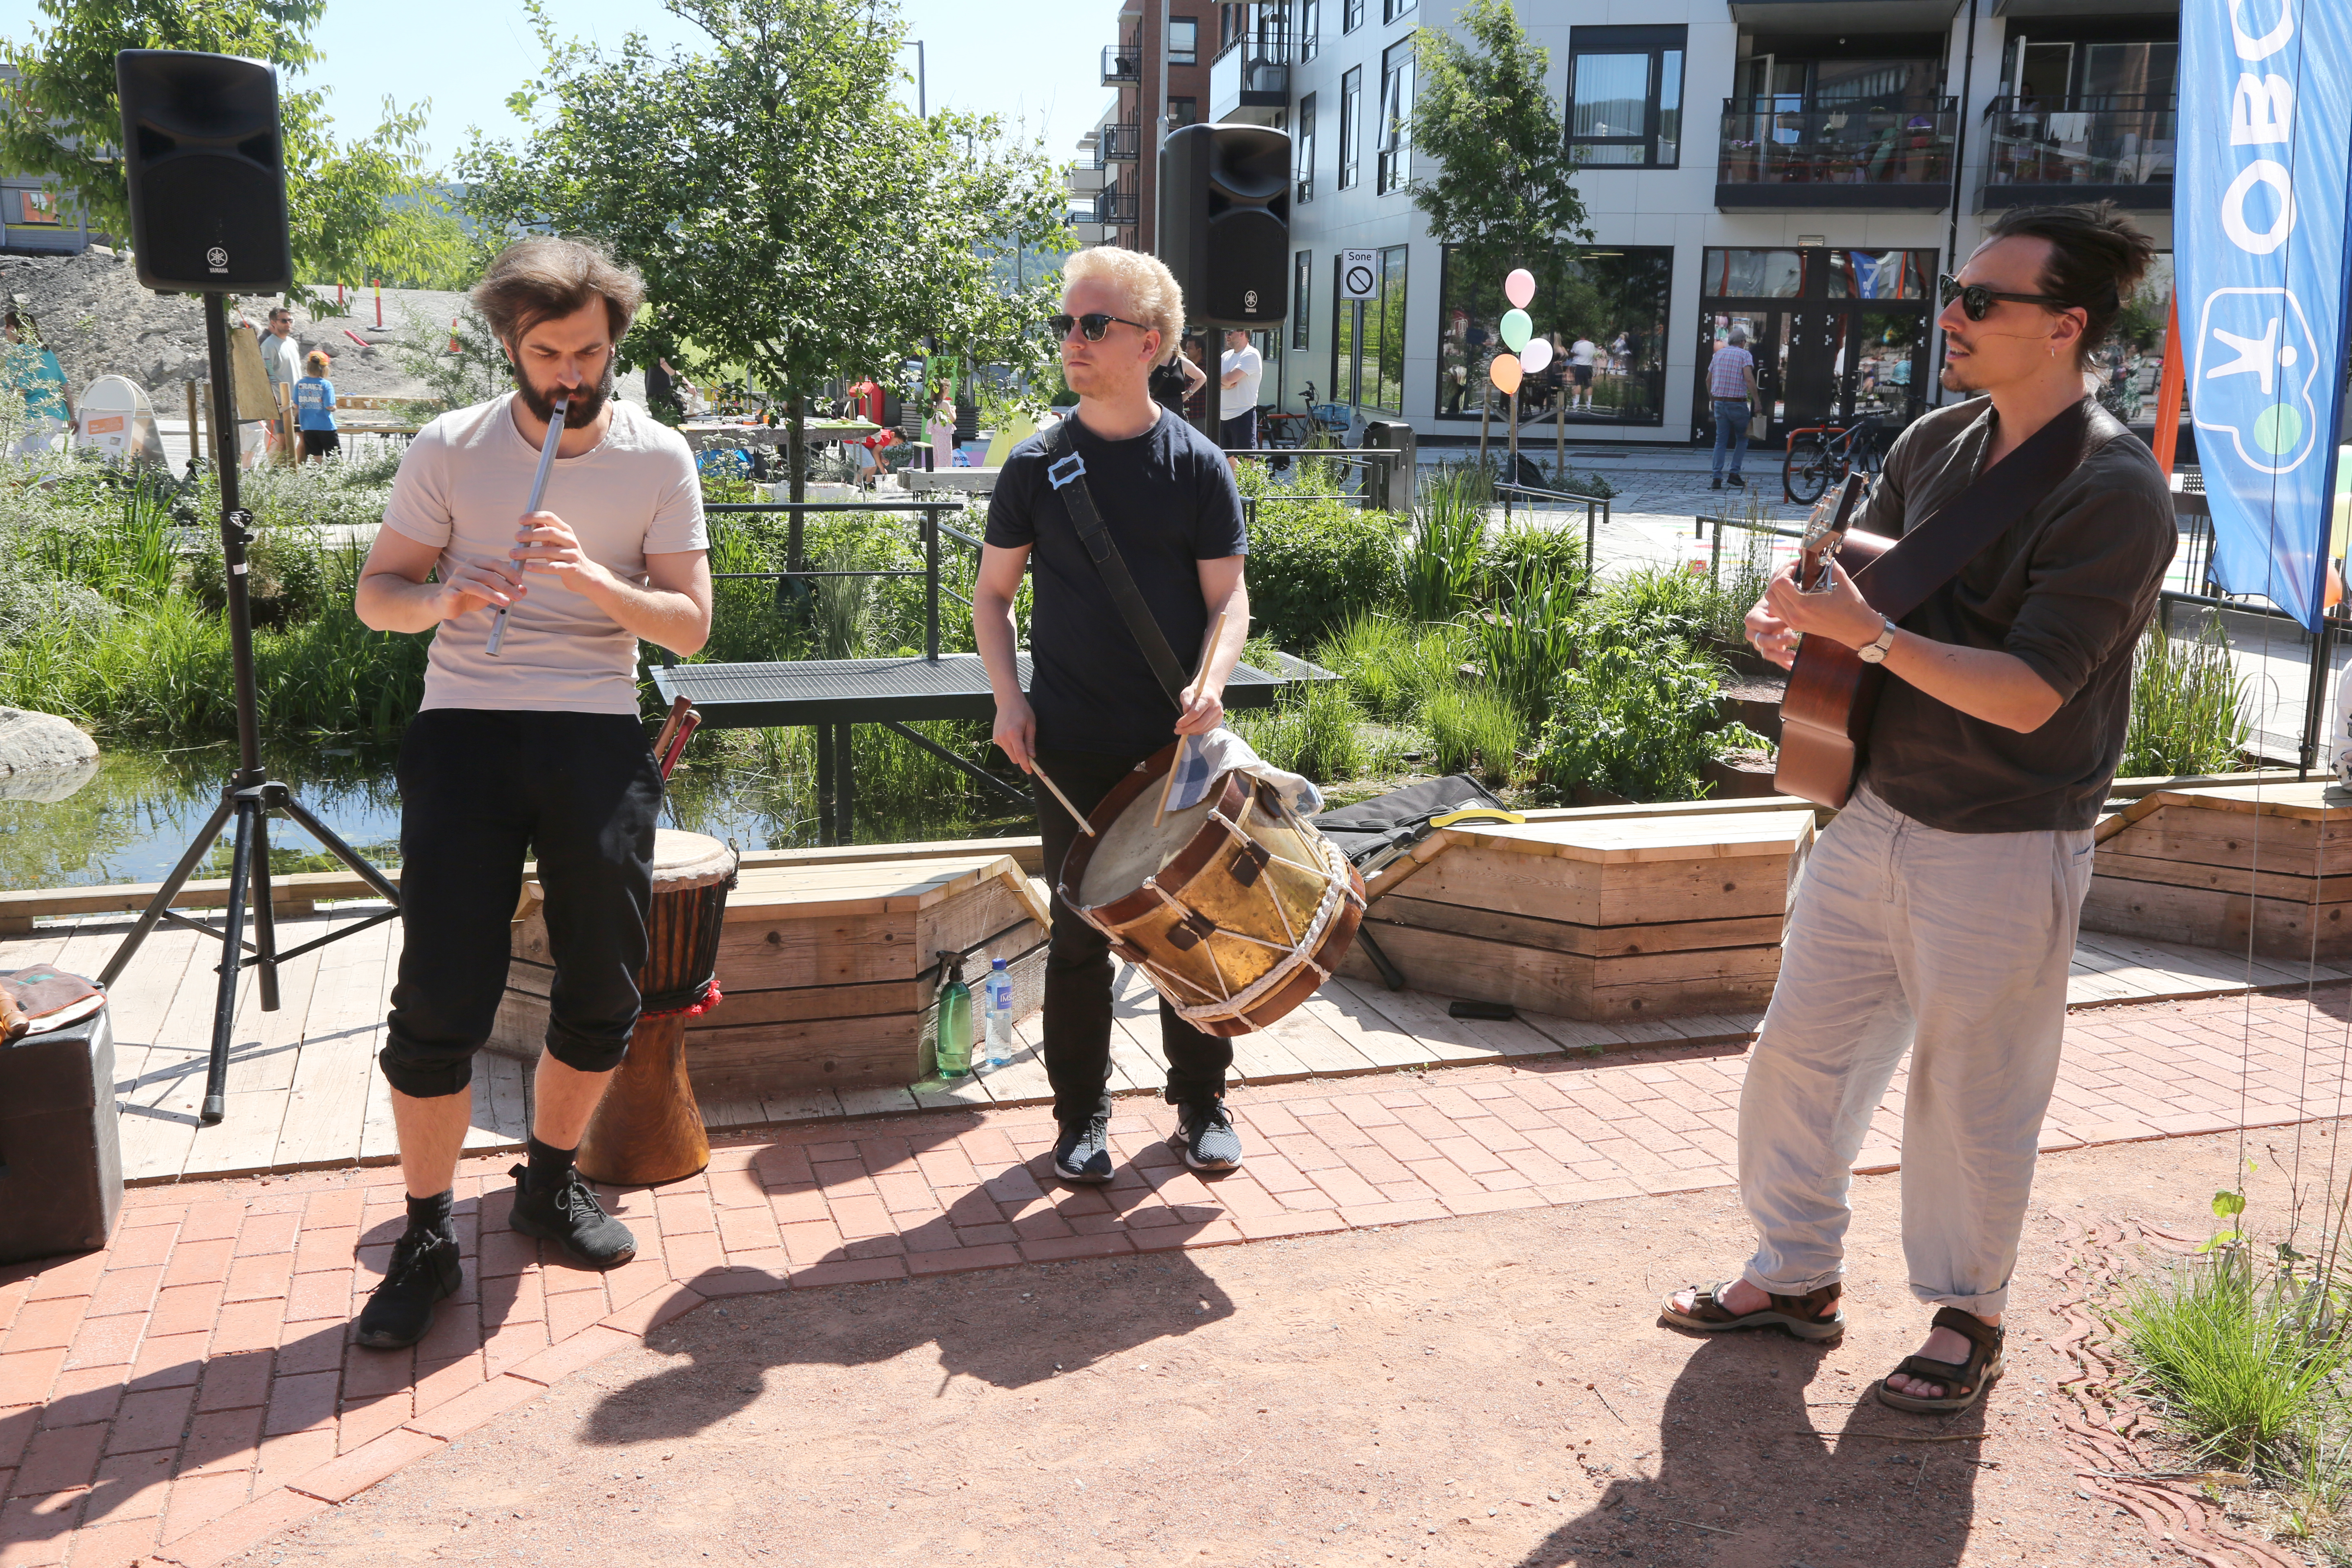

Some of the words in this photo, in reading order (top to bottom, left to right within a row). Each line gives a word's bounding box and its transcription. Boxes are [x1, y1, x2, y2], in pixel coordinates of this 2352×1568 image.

[1349, 252, 1372, 261] Sone
[1863, 263, 1896, 288] 71
[1000, 993, 1013, 1002] IMS
